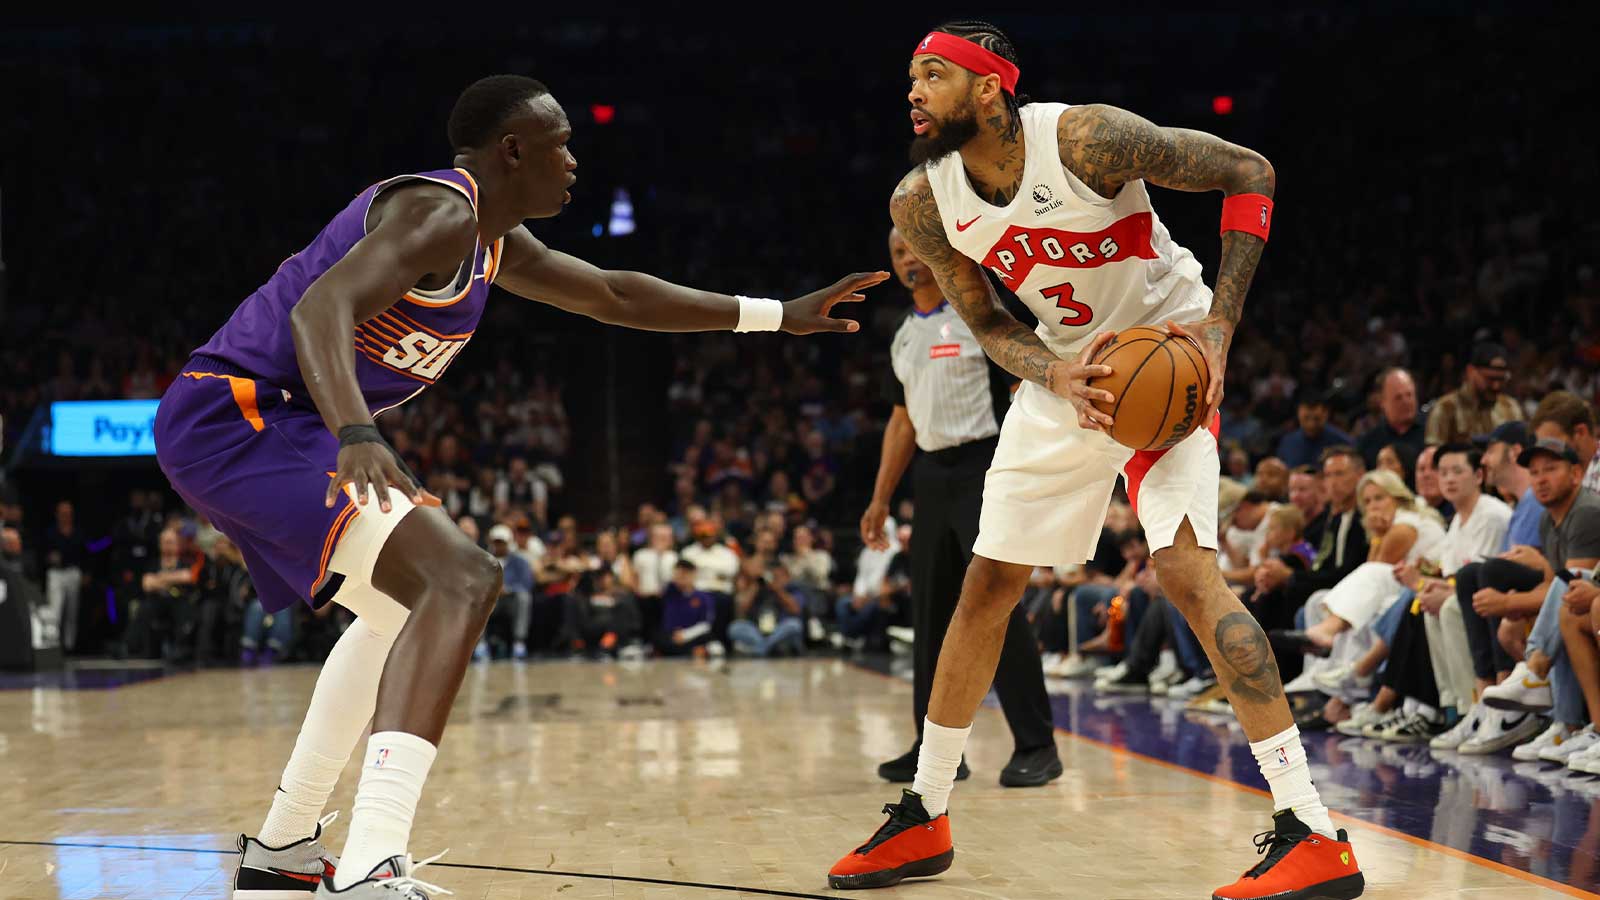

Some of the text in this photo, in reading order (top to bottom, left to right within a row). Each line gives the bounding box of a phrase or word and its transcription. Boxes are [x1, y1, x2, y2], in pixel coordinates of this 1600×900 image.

[1034, 199, 1064, 217] Sun Life
[1039, 281, 1094, 327] 3
[382, 331, 470, 379] SU
